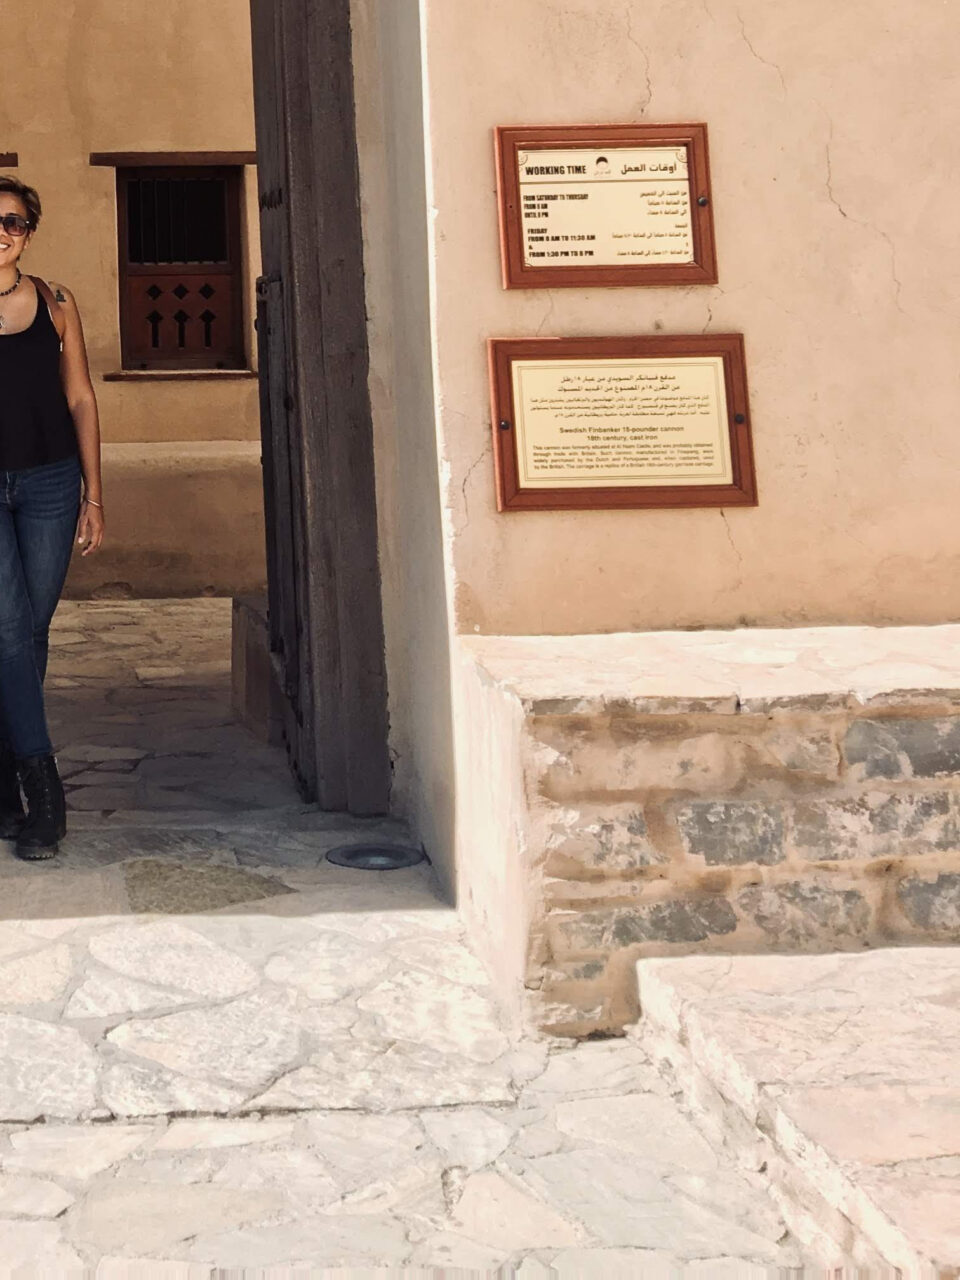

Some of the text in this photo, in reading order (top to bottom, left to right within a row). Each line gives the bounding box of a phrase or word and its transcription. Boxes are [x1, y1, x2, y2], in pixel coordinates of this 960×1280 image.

[525, 165, 565, 175] WORKING
[566, 165, 586, 174] TIME
[621, 163, 646, 175] العمل
[660, 374, 676, 383] مدفع
[559, 426, 587, 434] Swedish
